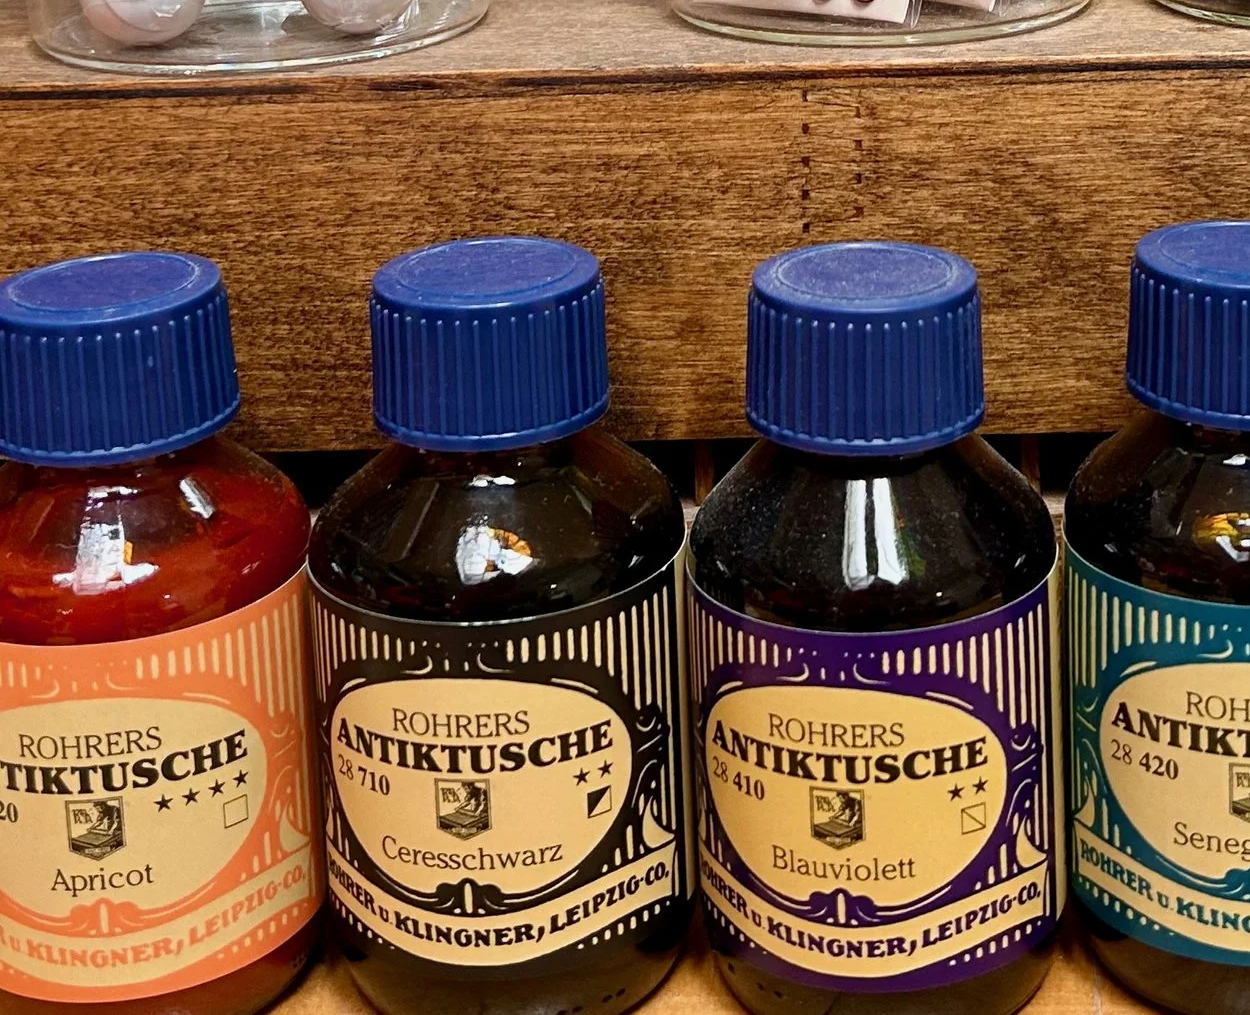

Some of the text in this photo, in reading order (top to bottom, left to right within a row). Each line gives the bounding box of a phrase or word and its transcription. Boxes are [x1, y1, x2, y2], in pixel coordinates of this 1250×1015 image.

[19, 726, 162, 760] ROHRERS
[392, 708, 531, 739] ROHRERS
[768, 712, 905, 747] ROHRERS
[0, 729, 248, 795] TIKTUSCHE
[336, 719, 614, 774] ANTIKTUSCHE
[711, 720, 988, 784] ANTIKTUSCHE
[1109, 738, 1180, 781] 28 420
[337, 754, 390, 797] 28 710
[712, 759, 765, 801] 28 410
[381, 835, 564, 872] Ceresschwarz
[771, 844, 916, 882] Blauviolett
[1078, 838, 1154, 899] ROHRER
[51, 864, 154, 898] Apricot
[701, 856, 749, 920] OHRER
[767, 915, 916, 959] KLINGNER,
[394, 911, 545, 948] KLINGNER,
[25, 935, 184, 969] KLINGNER,
